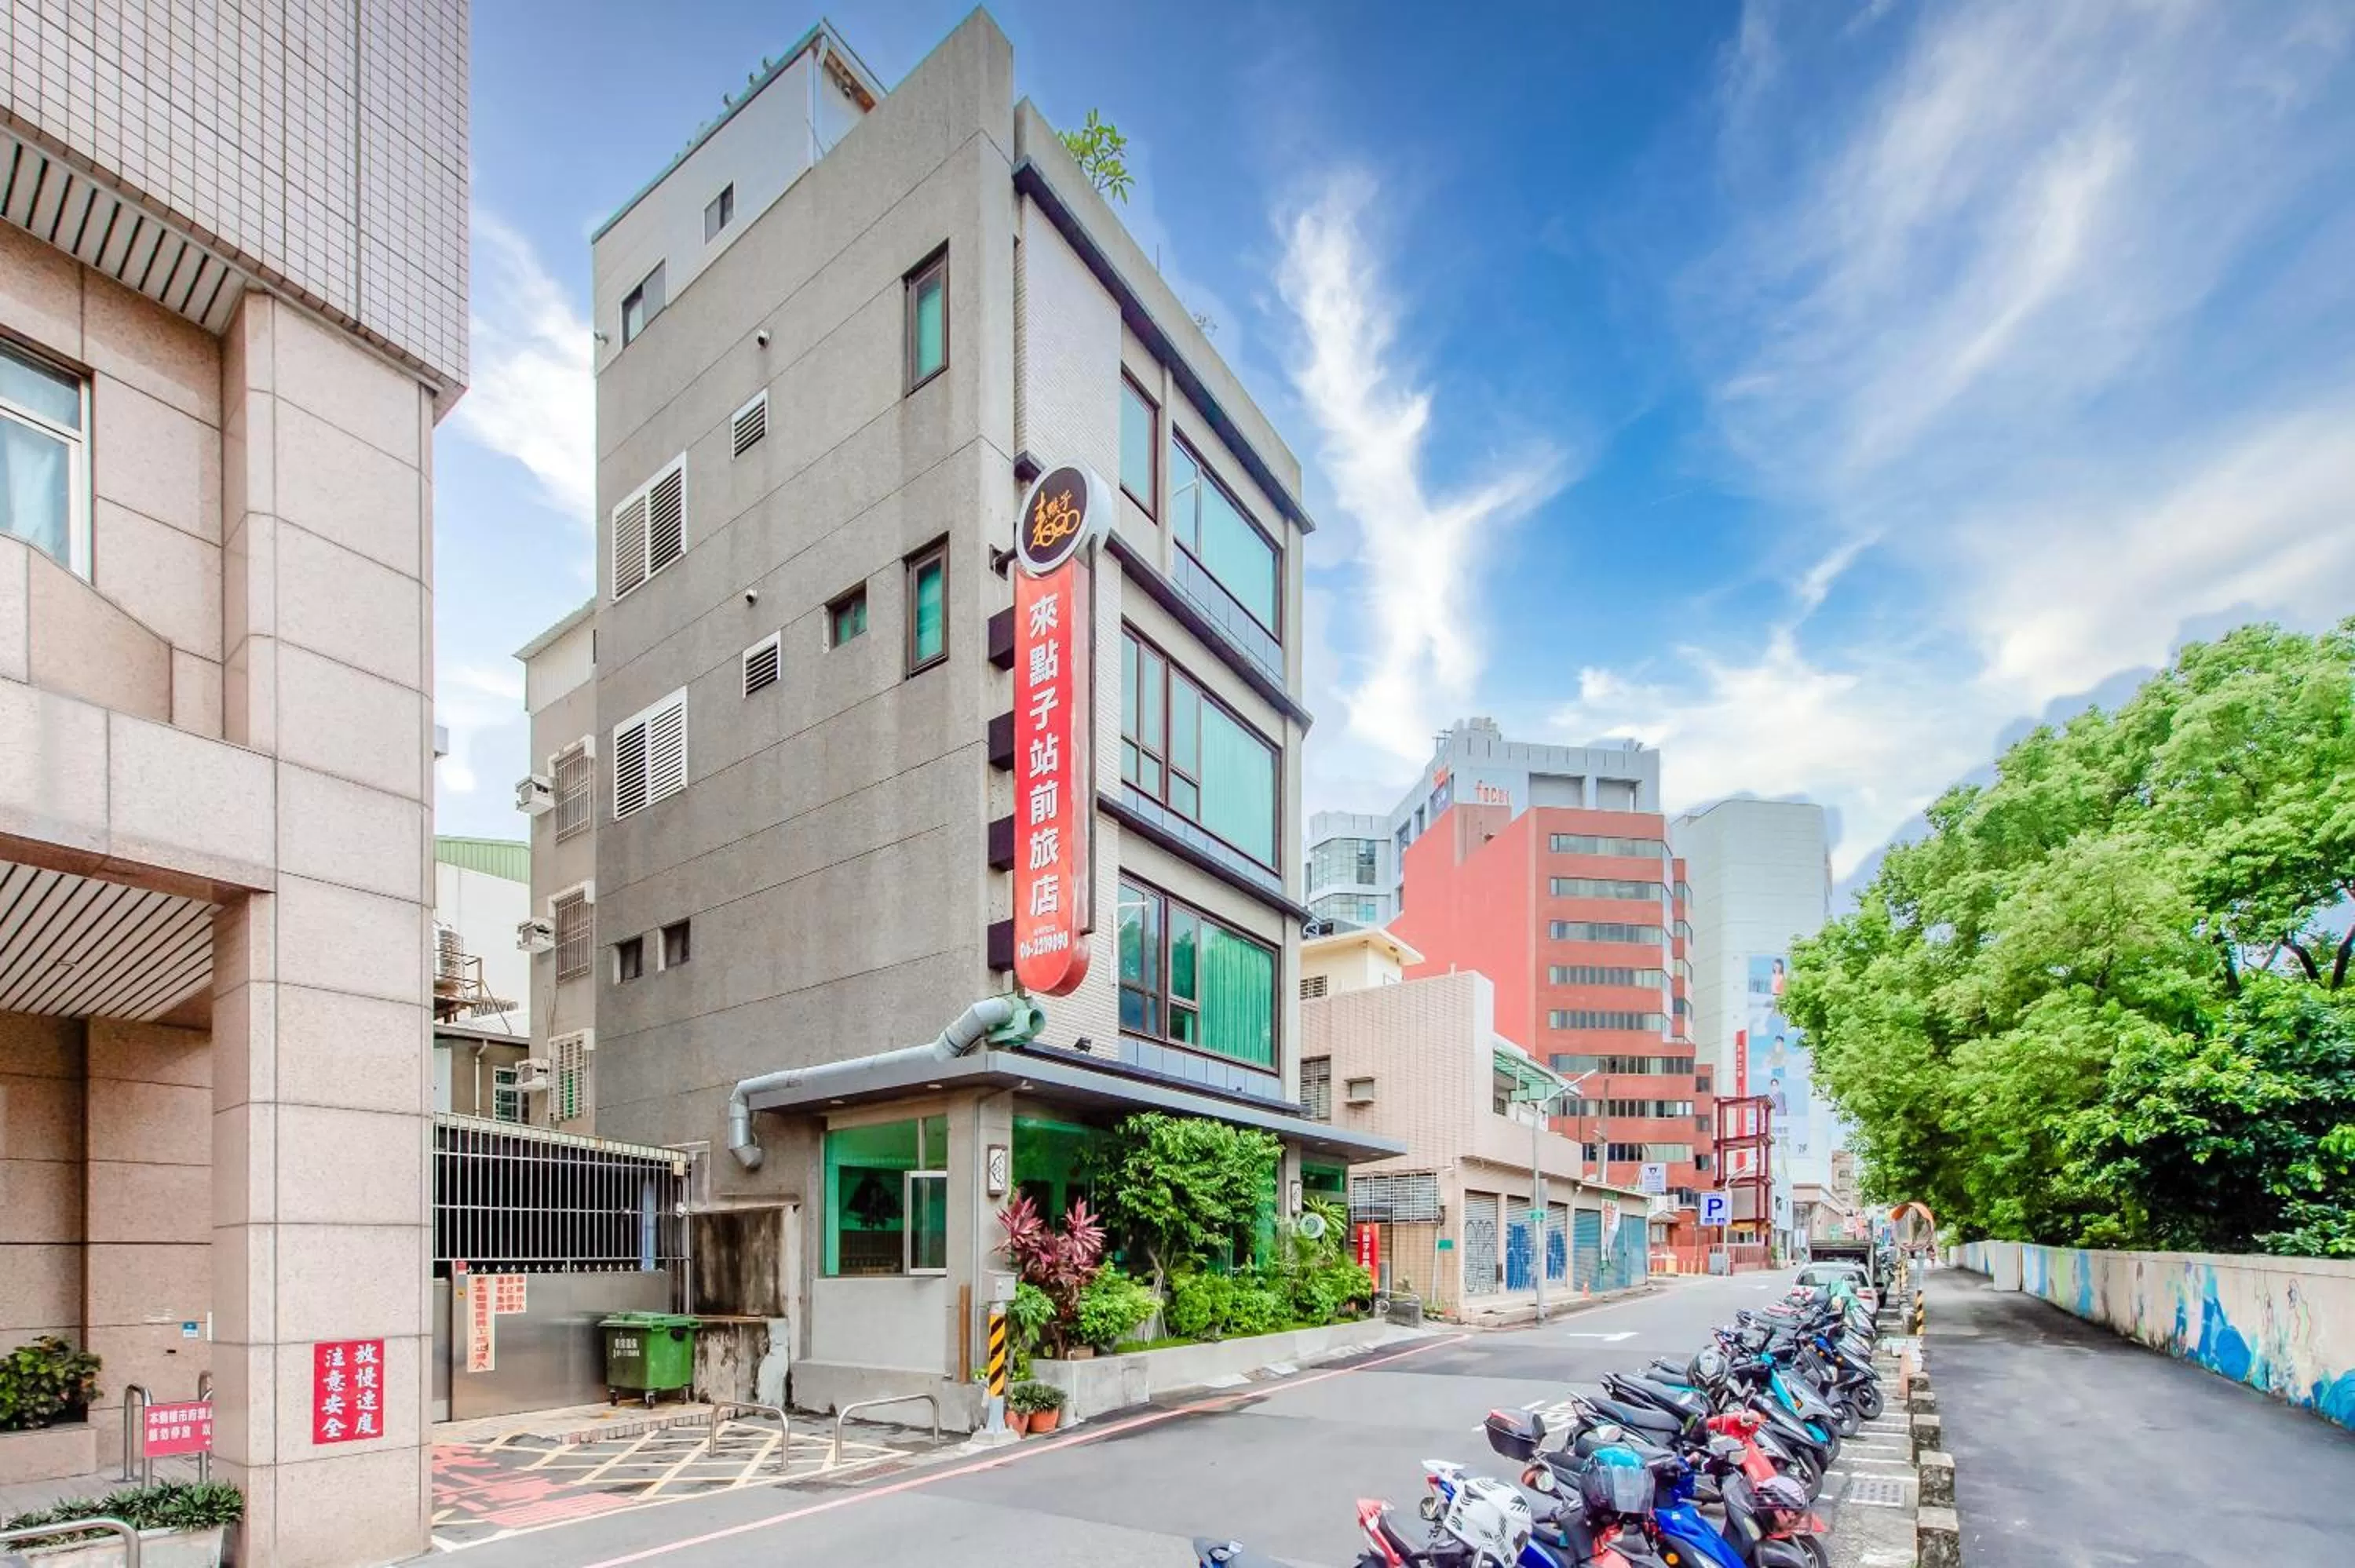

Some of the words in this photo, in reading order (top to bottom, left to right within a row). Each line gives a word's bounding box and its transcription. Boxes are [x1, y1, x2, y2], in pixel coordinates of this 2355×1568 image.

[1029, 593, 1060, 917] 來點子站前旅店
[1707, 1198, 1723, 1216] P
[321, 1346, 348, 1439] 注意安全
[354, 1343, 380, 1435] 放慢速度
